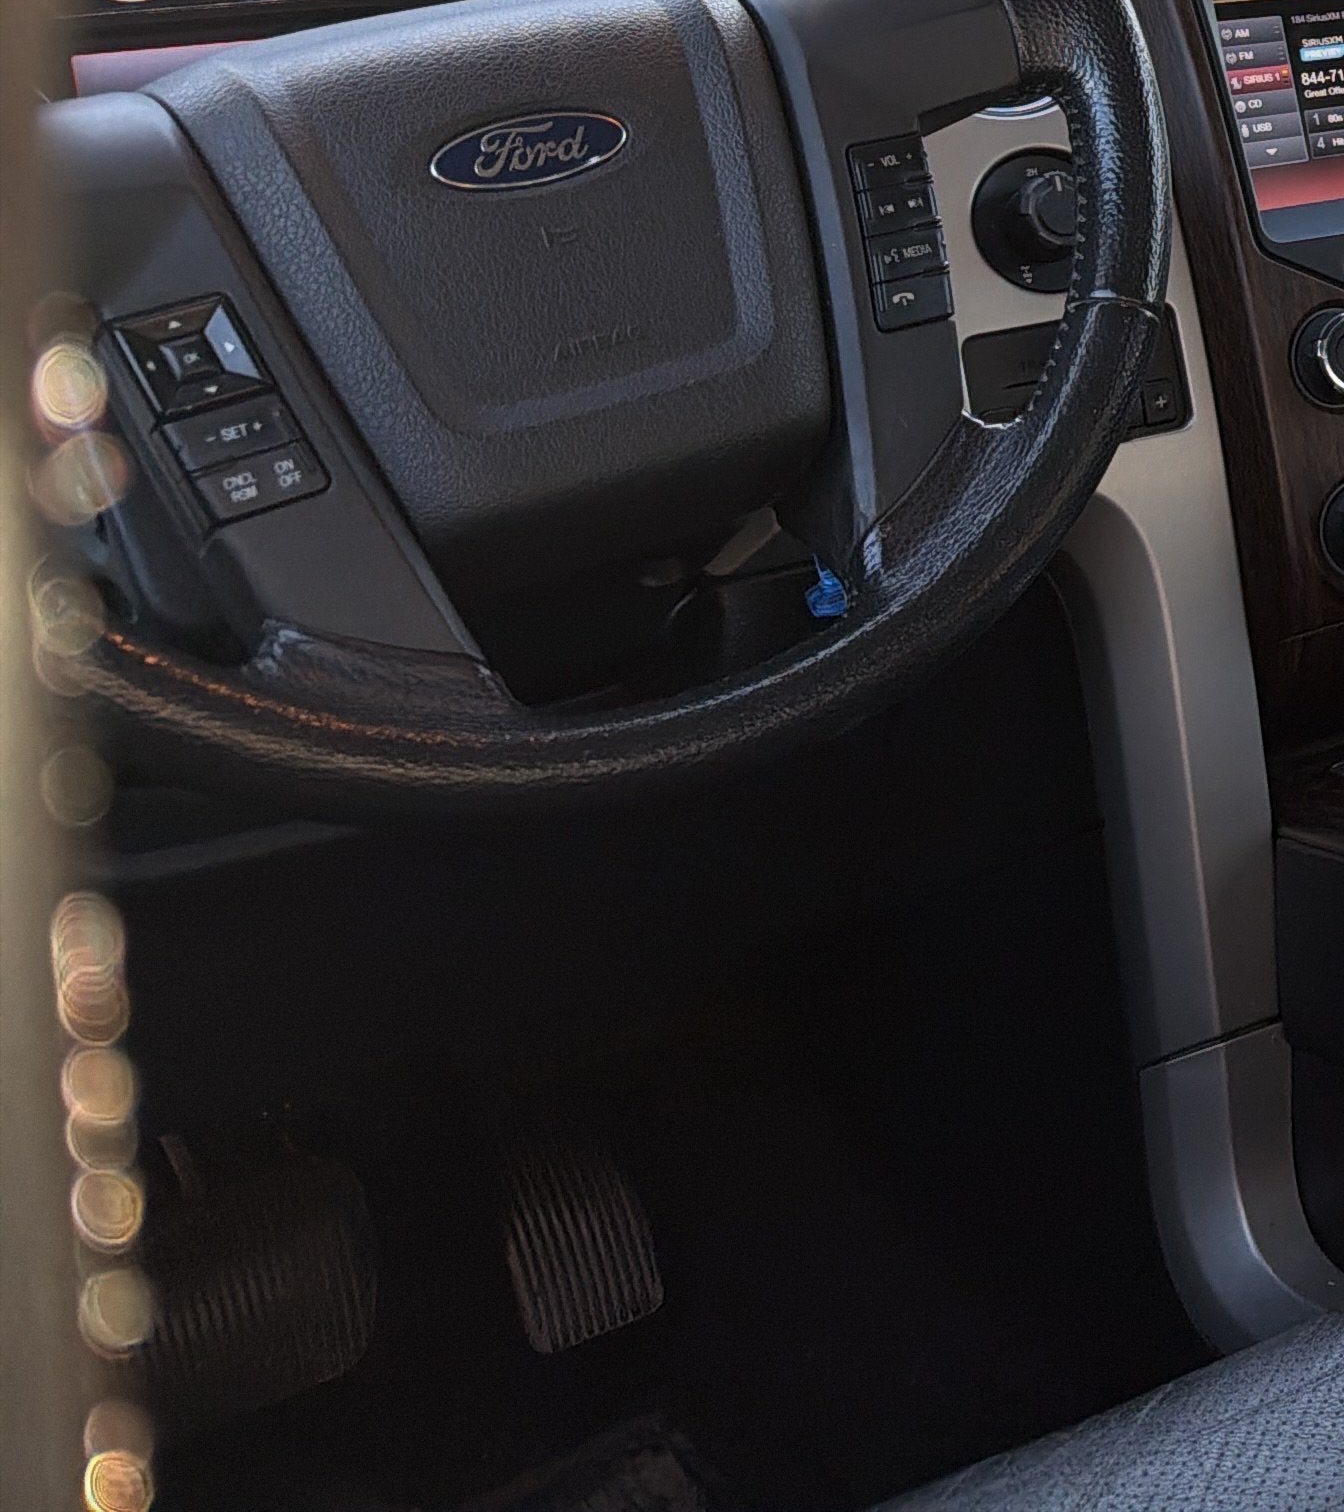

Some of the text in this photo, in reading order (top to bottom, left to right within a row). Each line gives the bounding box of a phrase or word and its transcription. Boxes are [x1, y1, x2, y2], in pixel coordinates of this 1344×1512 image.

[1290, 14, 1306, 24] 184
[1306, 11, 1340, 23] SiriusXM
[1235, 28, 1250, 38] AM
[1238, 51, 1254, 61] FM
[1243, 74, 1273, 85] SIRIUS
[1304, 88, 1328, 99] Great
[1247, 99, 1263, 109] CD
[1312, 112, 1321, 126] 1
[1252, 122, 1273, 133] USB
[474, 121, 590, 179] Ford
[1317, 137, 1326, 150] 4
[881, 154, 901, 168] VOL
[1026, 167, 1039, 177] 2H
[902, 244, 933, 258] MEDIA
[183, 352, 200, 364] OK
[220, 423, 248, 441] SET
[273, 459, 295, 474] ON
[223, 472, 258, 490] CNCL
[279, 470, 302, 487] OFF
